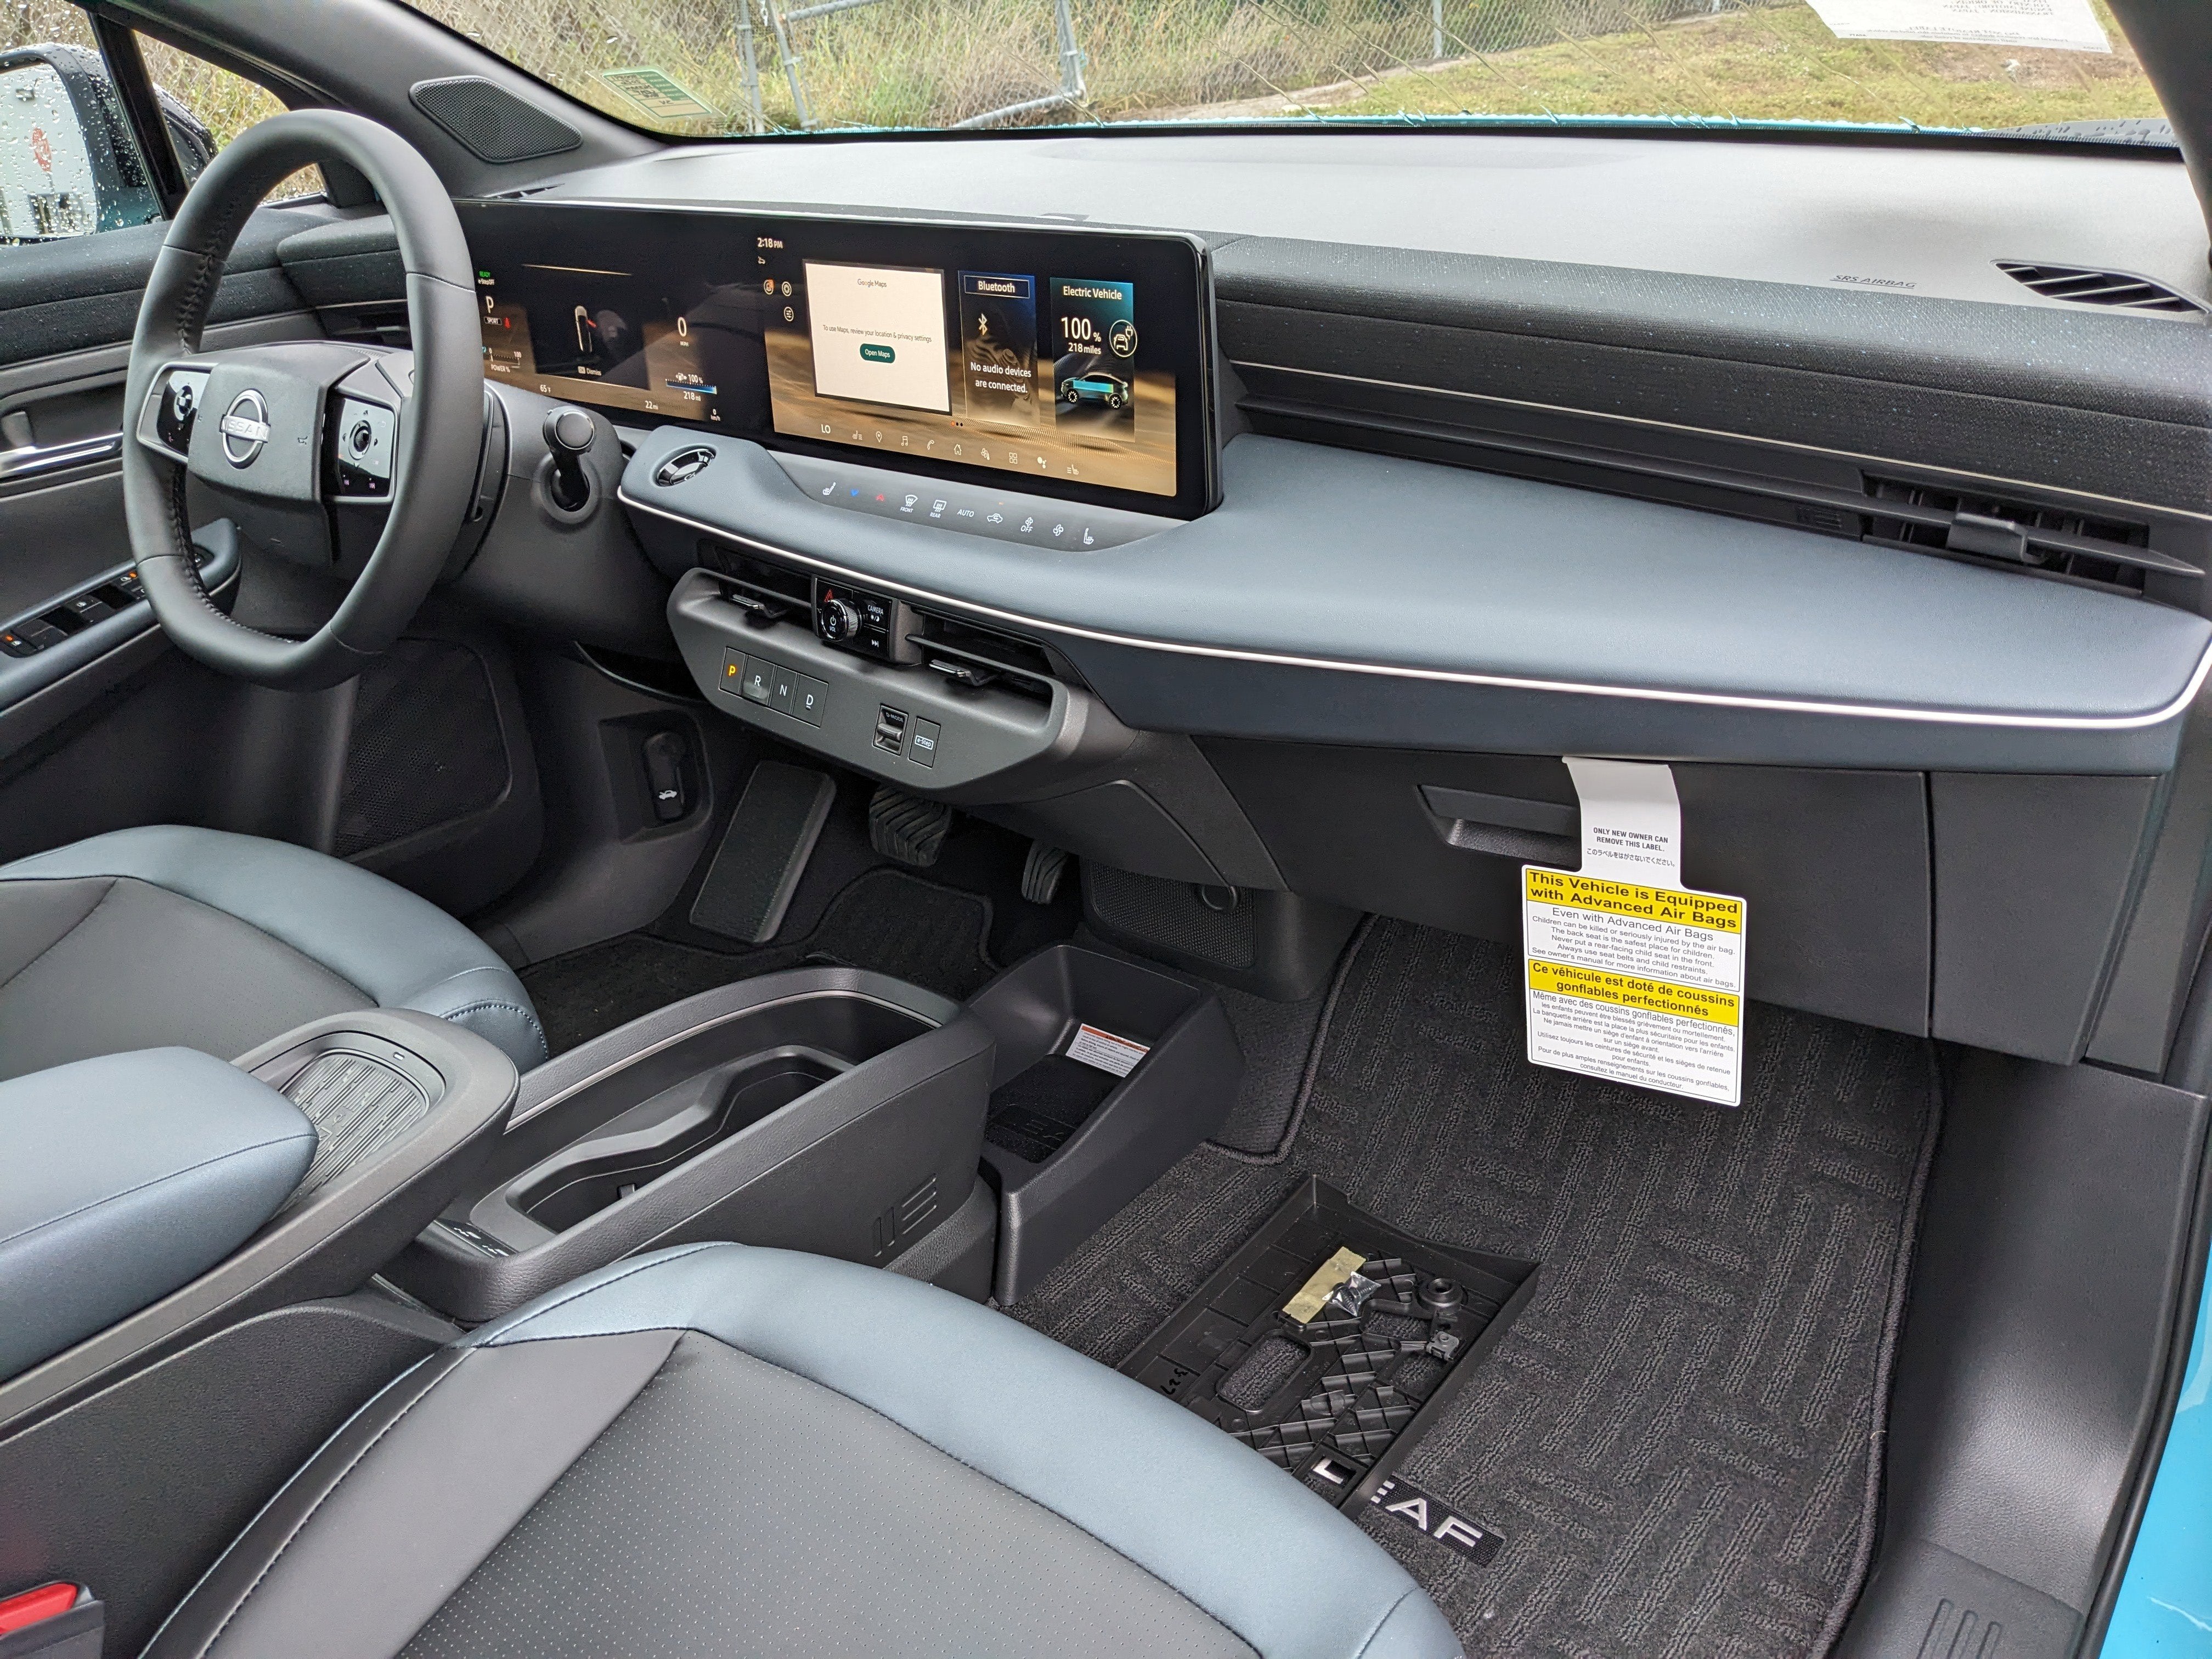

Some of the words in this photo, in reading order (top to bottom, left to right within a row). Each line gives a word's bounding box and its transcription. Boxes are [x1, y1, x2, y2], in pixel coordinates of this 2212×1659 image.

[757, 237, 773, 248] 2:18
[774, 240, 783, 249] PM
[857, 278, 874, 287] Google
[978, 281, 1015, 294] Bluetooth
[1861, 278, 1916, 288] AIRBAG
[1063, 285, 1091, 298] Electric
[1092, 287, 1122, 300] Vehicle
[486, 296, 494, 313] P
[678, 317, 687, 337] 0
[837, 326, 849, 334] Maps,
[875, 330, 893, 338] location
[898, 332, 914, 341] privacy
[915, 334, 932, 343] settings
[1061, 317, 1091, 340] 100
[865, 348, 878, 357] Open
[878, 350, 890, 358] Maps
[490, 364, 506, 372] POWER
[970, 362, 981, 373] No
[983, 363, 1003, 374] audio
[1005, 364, 1031, 378] devices
[975, 379, 987, 388] are
[988, 380, 1028, 394] connected.
[221, 417, 269, 439] NISSAN
[821, 424, 831, 434] LO
[900, 506, 913, 514] FRONT
[957, 508, 975, 518] AUTO
[1020, 525, 1034, 533] OFF
[867, 605, 884, 615] CAMERA
[729, 665, 736, 676] P
[754, 675, 761, 686] R
[780, 685, 787, 696] N
[806, 695, 814, 706] D
[885, 712, 904, 723] D-MODE
[917, 737, 932, 747] e-Step
[1596, 836, 1623, 845] REMOVE
[1642, 842, 1664, 851] LABEL.
[1628, 832, 1652, 841] OWNER
[1529, 871, 1564, 886] This
[1568, 877, 1629, 896] Vehicle
[1635, 888, 1649, 899] is
[1655, 891, 1737, 913] Equipped
[1530, 888, 1563, 900] with
[1570, 893, 1652, 915] Advanced
[1660, 907, 1685, 919] Air
[1692, 911, 1736, 928] Bags
[1553, 907, 1579, 919] Even
[1582, 913, 1603, 923] with
[1607, 916, 1661, 932] Advanced
[1665, 926, 1681, 935] Air
[1685, 928, 1713, 941] Bags
[1532, 916, 1561, 926] Children
[1589, 924, 1607, 933] killed
[1619, 930, 1652, 941] seriously
[1654, 935, 1679, 945] injured
[1681, 939, 1690, 947] by
[1719, 946, 1735, 955] bag.
[1551, 934, 1572, 943] Never
[1594, 943, 1633, 955] rear-facing
[1695, 958, 1714, 967] front.
[1567, 929, 1583, 937] back
[1683, 949, 1714, 959] children.
[1557, 944, 1582, 953] Always
[1617, 953, 1634, 961] belts
[1671, 964, 1707, 974] restraints.
[1548, 951, 1575, 960] owner's
[1577, 956, 1602, 964] manual
[1637, 964, 1678, 977] information
[1680, 973, 1701, 981] about
[1715, 978, 1735, 988] bags.
[1533, 962, 1548, 973] Ce
[1551, 967, 1601, 983] véhicule
[1605, 977, 1623, 987] est
[1627, 979, 1654, 992] doté
[1658, 985, 1673, 996] de
[1677, 990, 1734, 1007] coussins
[1556, 982, 1618, 999] gonflables
[1623, 994, 1708, 1015] perfectionnés
[1533, 990, 1556, 1002] Même
[1559, 997, 1577, 1006] avec
[1579, 1000, 1593, 1009] des
[1595, 1004, 1629, 1015] coussins
[1632, 1011, 1673, 1024] gonflables
[1676, 1019, 1735, 1036] perfectionnés,
[1623, 1041, 1639, 1049] siège
